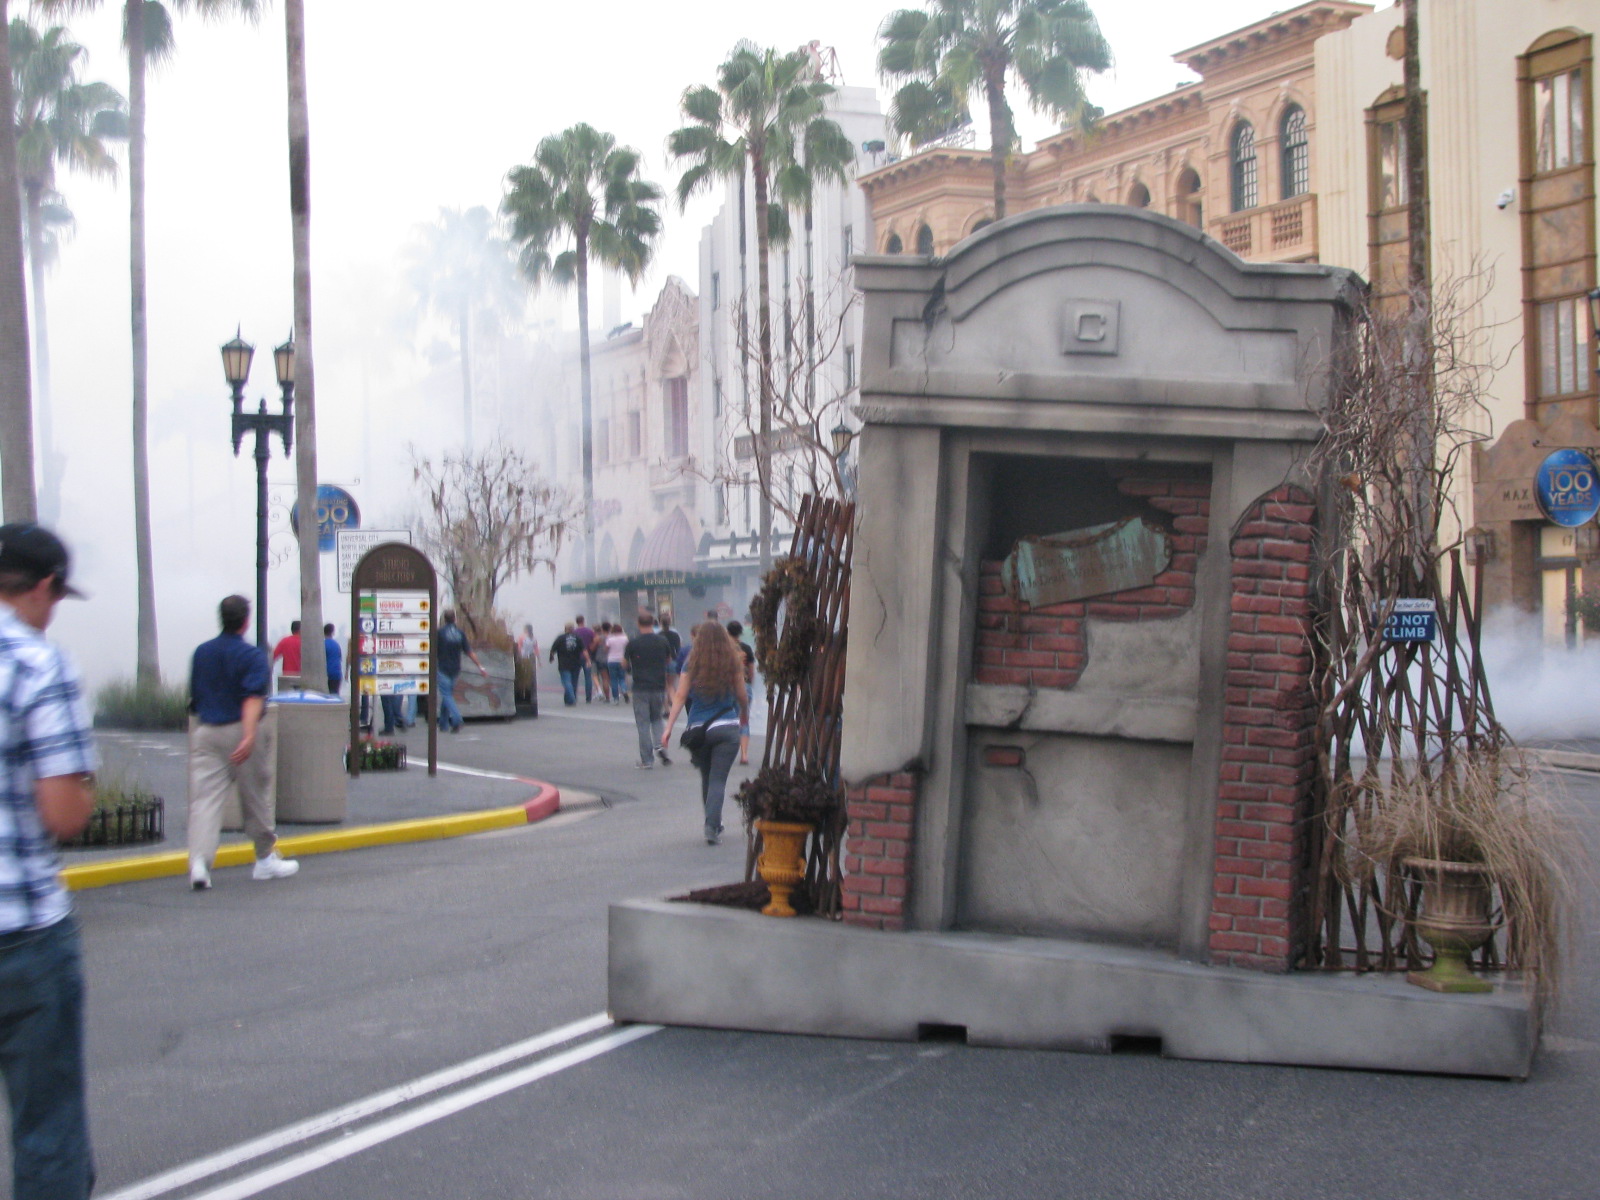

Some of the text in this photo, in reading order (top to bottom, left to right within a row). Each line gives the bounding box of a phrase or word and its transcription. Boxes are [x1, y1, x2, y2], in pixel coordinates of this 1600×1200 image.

[1548, 471, 1592, 492] 100
[1503, 489, 1529, 501] MAX
[1548, 492, 1592, 505] YEARS
[317, 505, 348, 523] 00
[382, 557, 410, 570] STUDIO
[379, 619, 394, 632] E.T.
[1402, 614, 1431, 626] NOT
[1383, 627, 1426, 638] CLIMB
